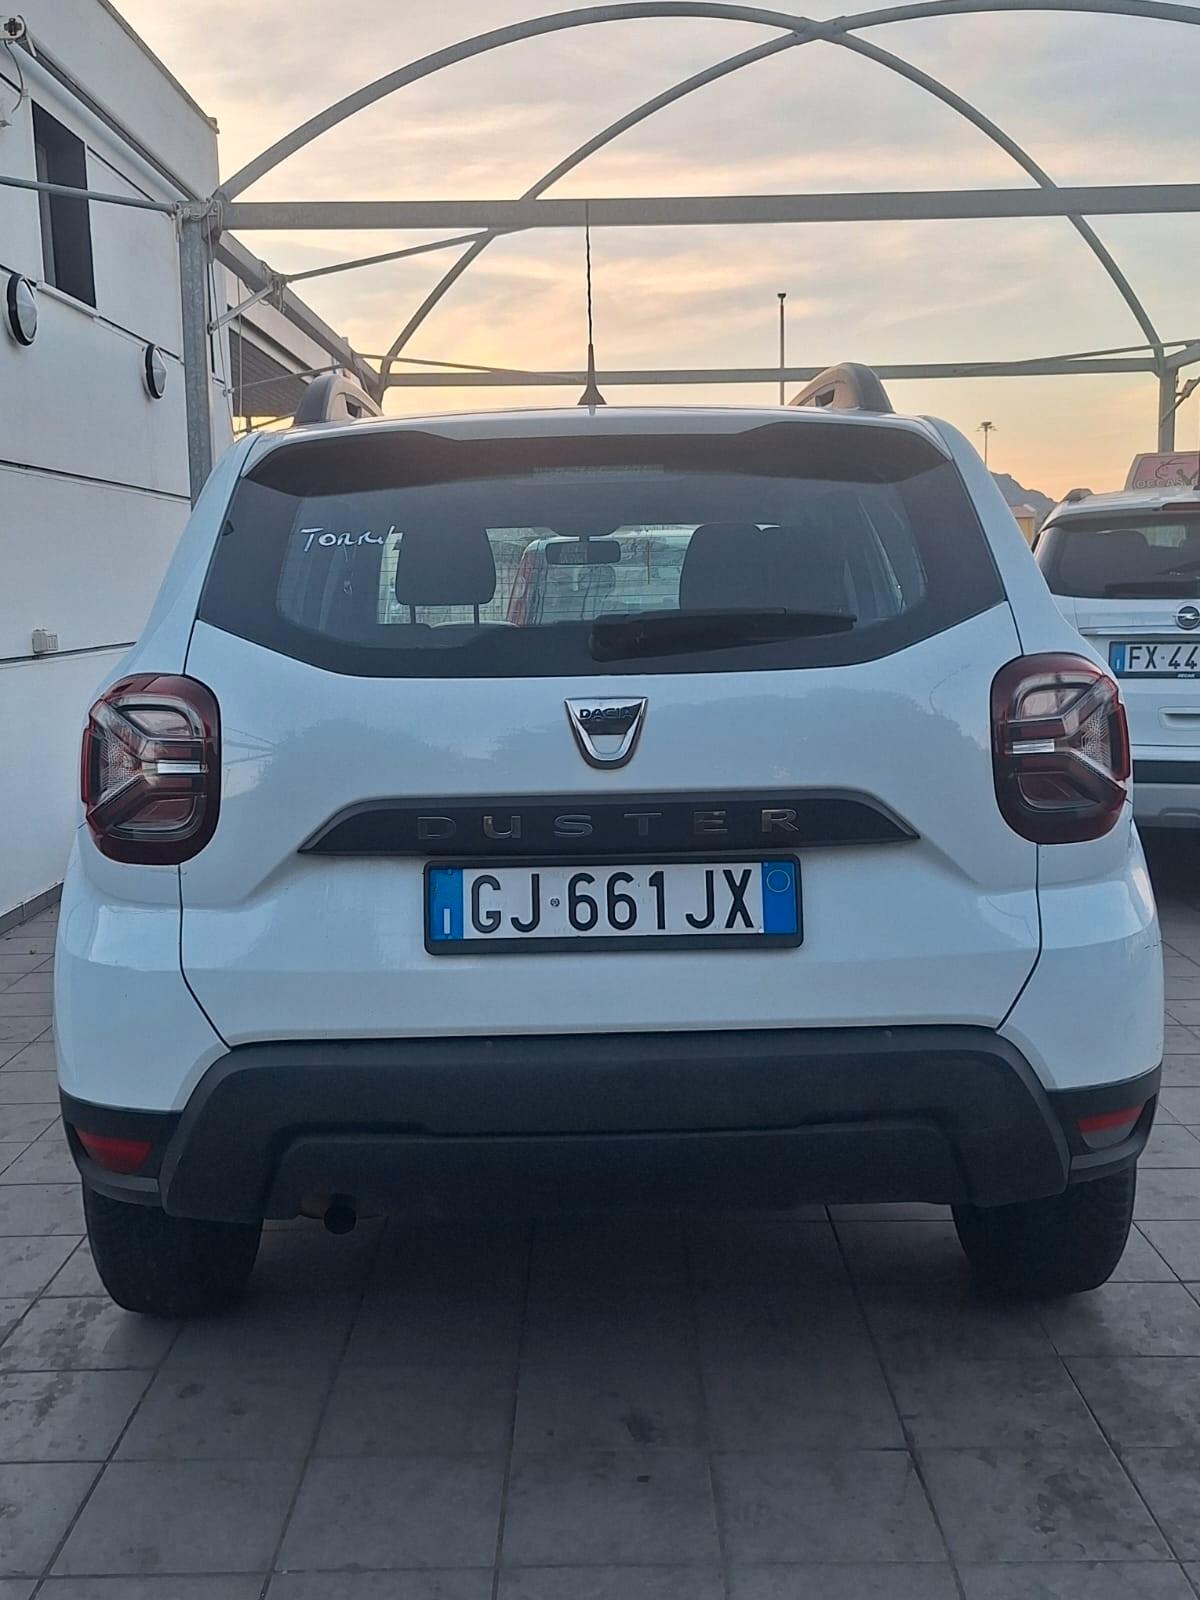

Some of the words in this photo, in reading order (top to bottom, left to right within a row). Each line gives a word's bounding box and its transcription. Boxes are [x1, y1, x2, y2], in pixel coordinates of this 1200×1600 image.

[1129, 645, 1158, 670] FX
[1168, 645, 1199, 670] 44
[580, 707, 633, 720] DACIA
[417, 808, 799, 840] DUSTER
[471, 874, 541, 934] GJ
[568, 870, 667, 932] 661
[685, 868, 755, 930] JX
